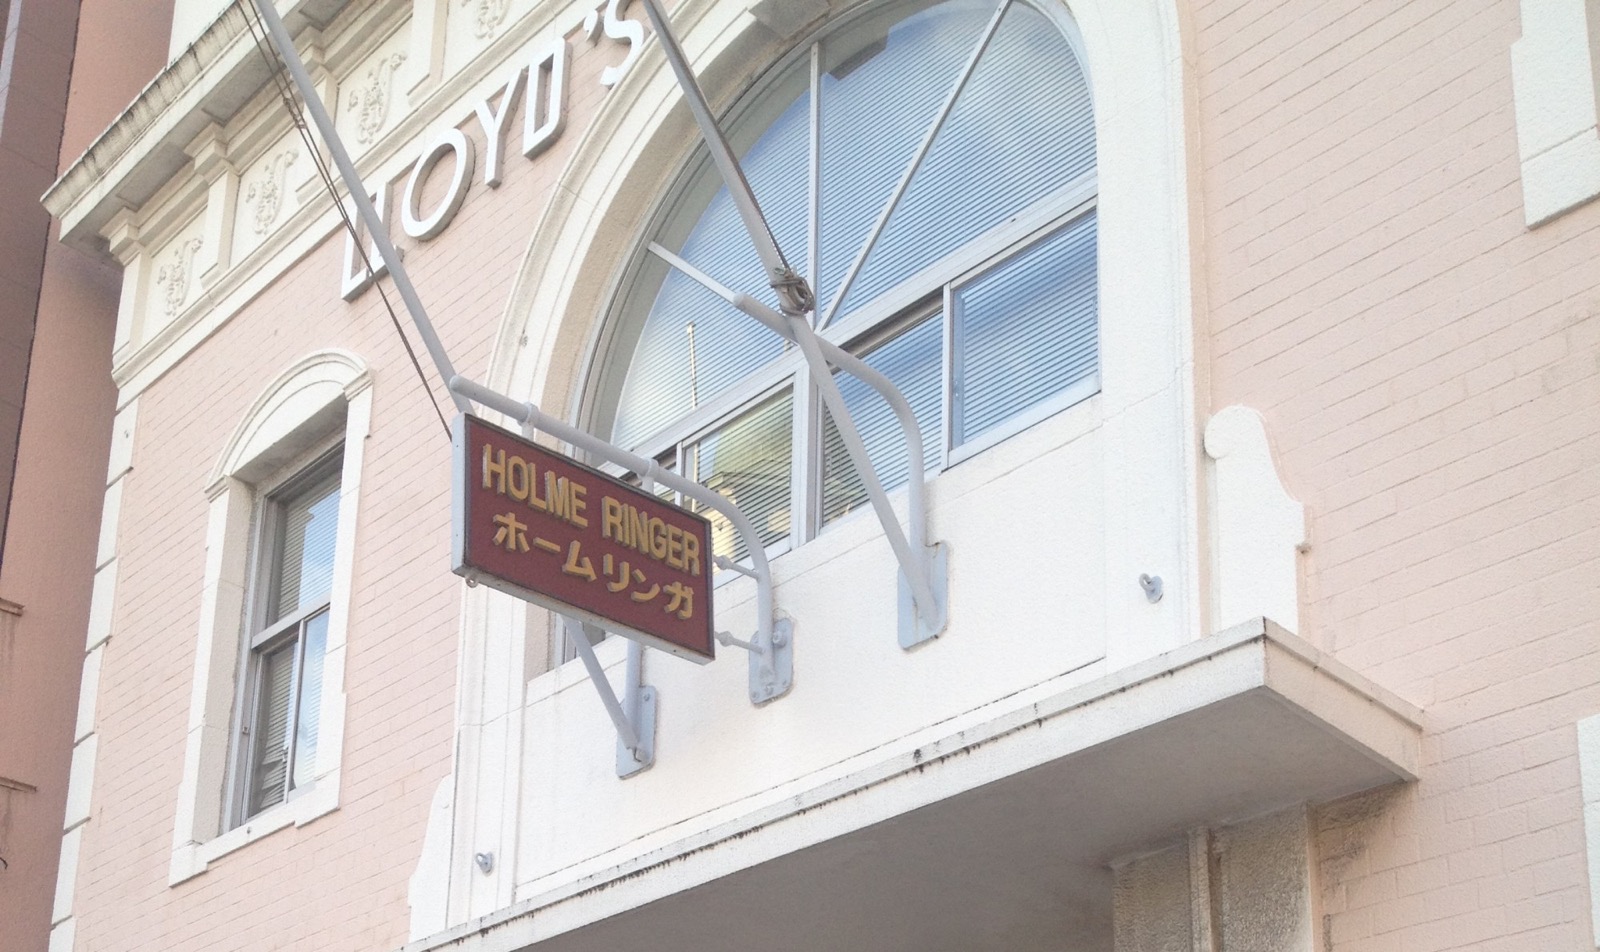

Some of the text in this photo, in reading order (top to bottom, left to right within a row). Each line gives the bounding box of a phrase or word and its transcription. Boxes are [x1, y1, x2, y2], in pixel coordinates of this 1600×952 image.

[482, 443, 700, 576] HOLME RINGER
[492, 512, 694, 620] ホームリンガ
